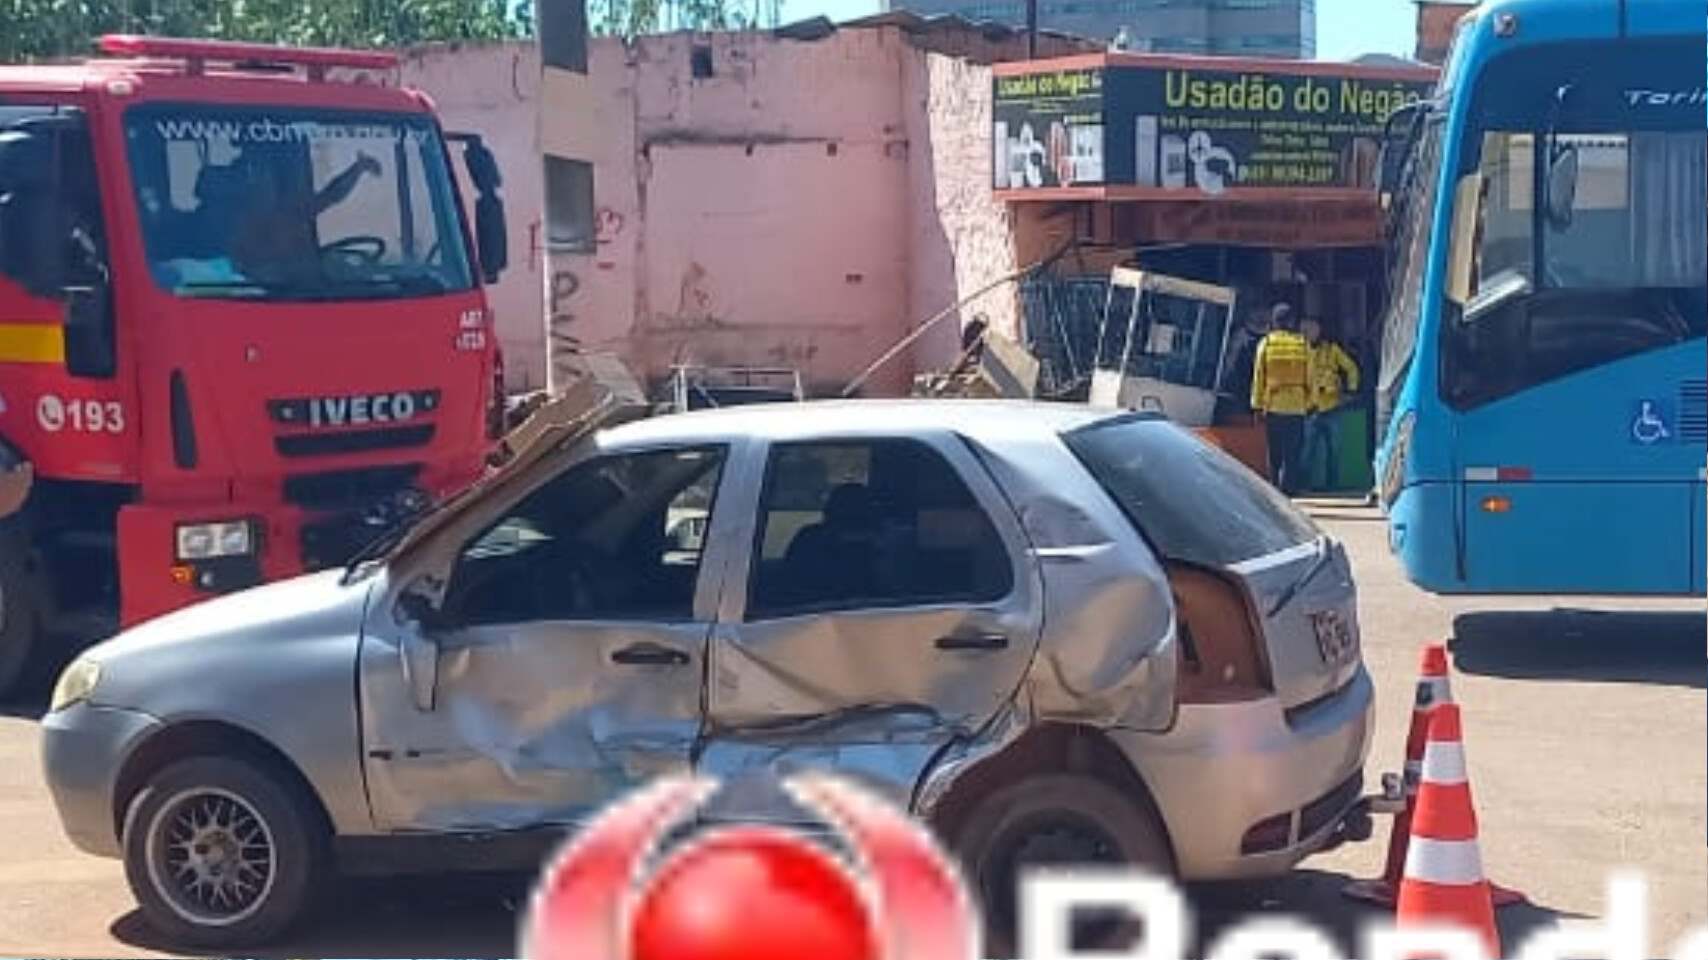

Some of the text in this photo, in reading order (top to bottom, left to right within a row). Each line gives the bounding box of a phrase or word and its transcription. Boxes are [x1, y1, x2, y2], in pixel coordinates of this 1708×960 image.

[1165, 71, 1420, 123] Usadão do Negão
[67, 399, 124, 432] 193
[310, 393, 414, 426] IVECO
